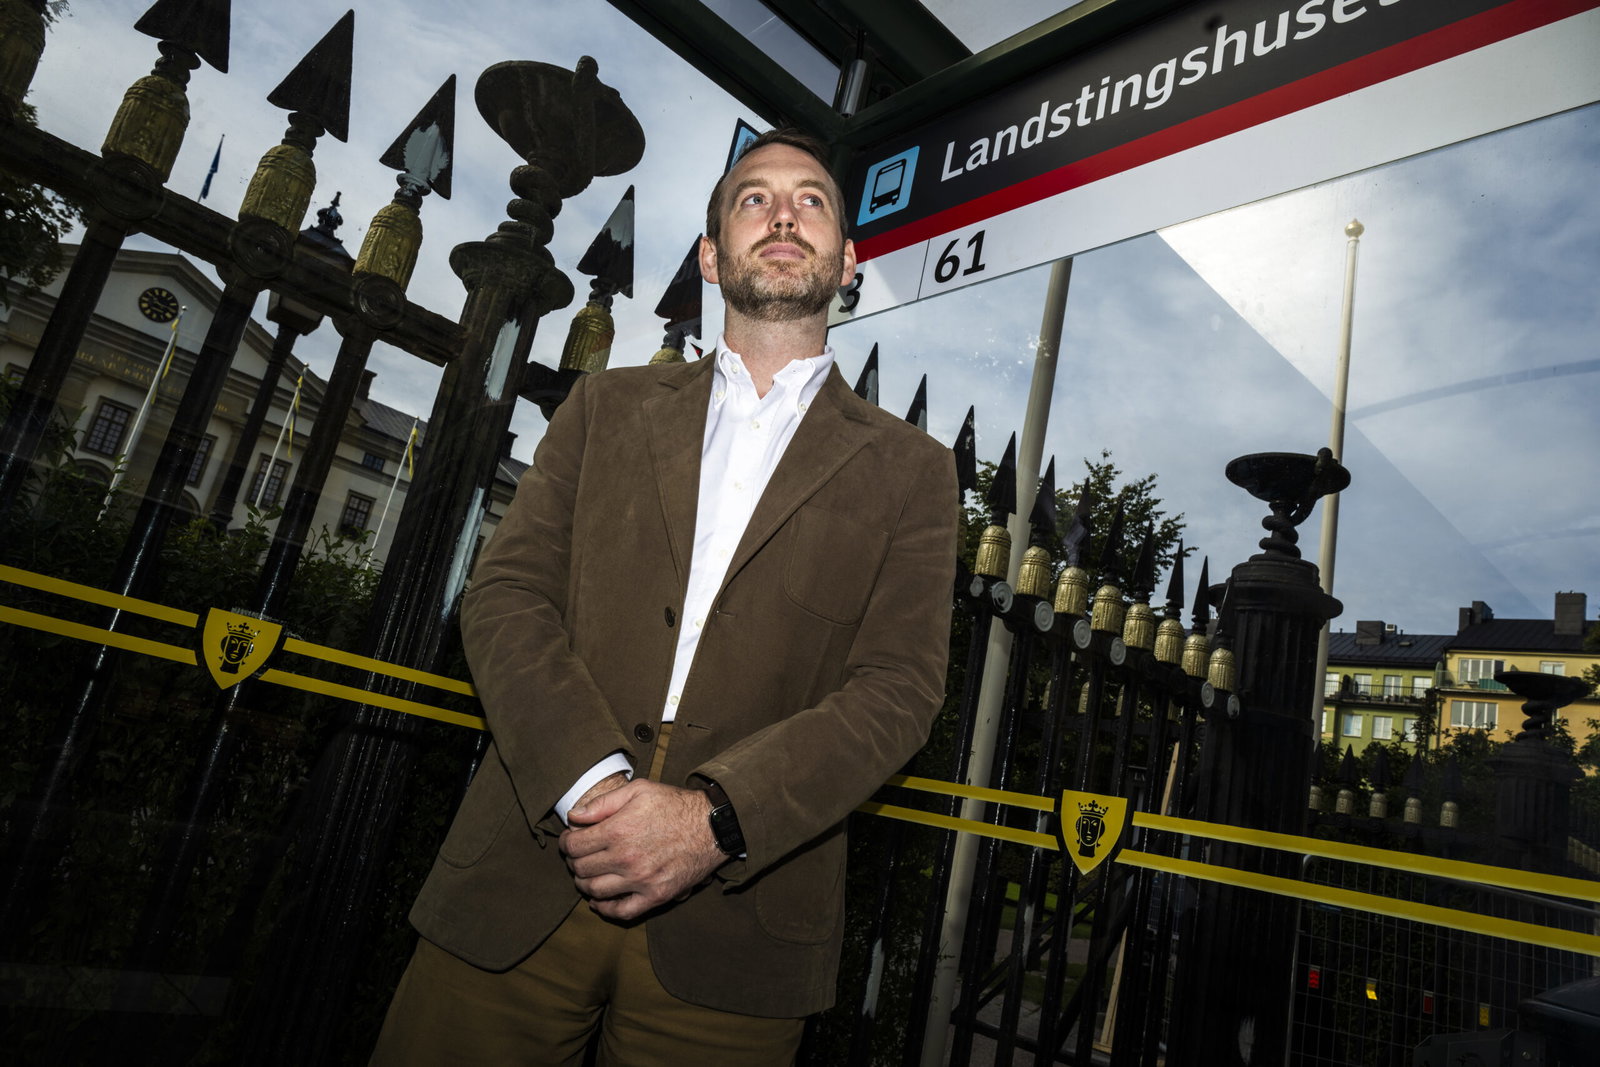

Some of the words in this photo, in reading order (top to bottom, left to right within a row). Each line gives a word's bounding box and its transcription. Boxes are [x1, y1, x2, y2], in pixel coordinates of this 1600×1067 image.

[940, 0, 1400, 182] Landstingshuse
[838, 272, 864, 313] 3
[934, 229, 986, 284] 61
